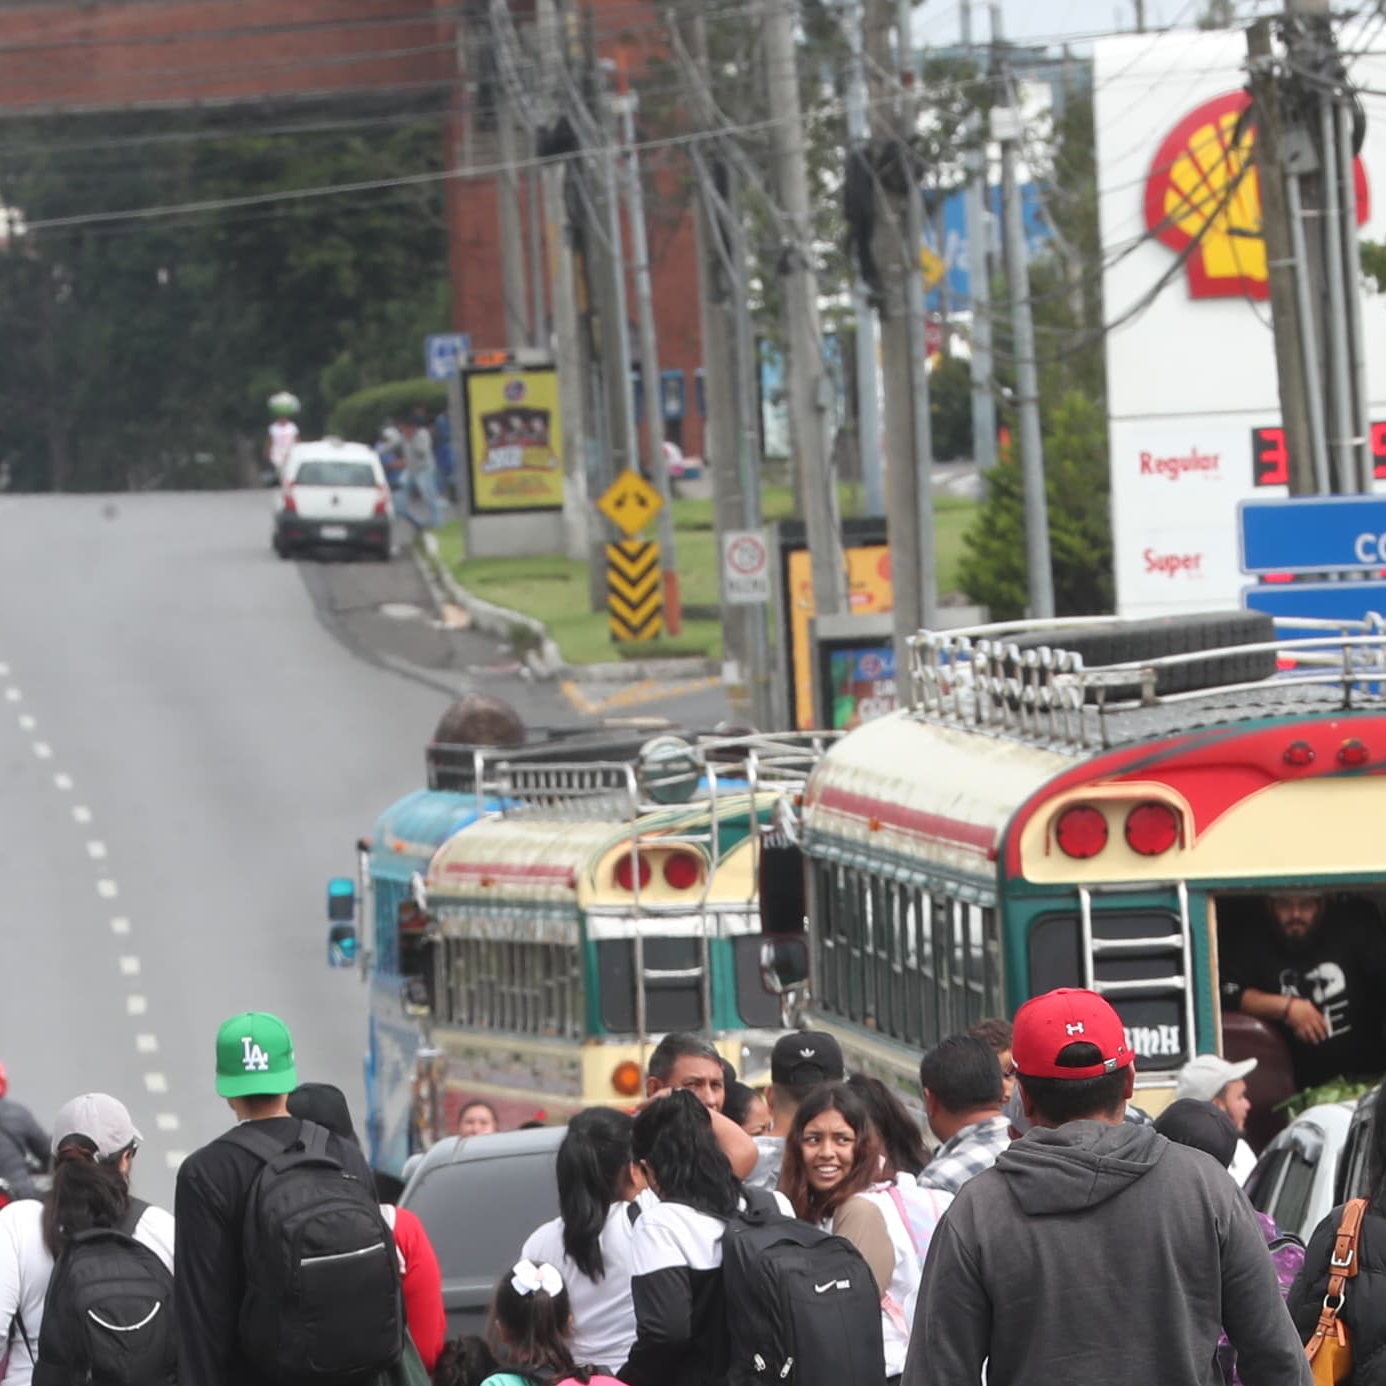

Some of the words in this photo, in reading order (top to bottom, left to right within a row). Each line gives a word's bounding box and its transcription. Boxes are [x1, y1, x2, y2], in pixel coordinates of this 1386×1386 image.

[1139, 447, 1220, 479] Regular
[1143, 548, 1202, 577] Super
[241, 1036, 269, 1071] LA
